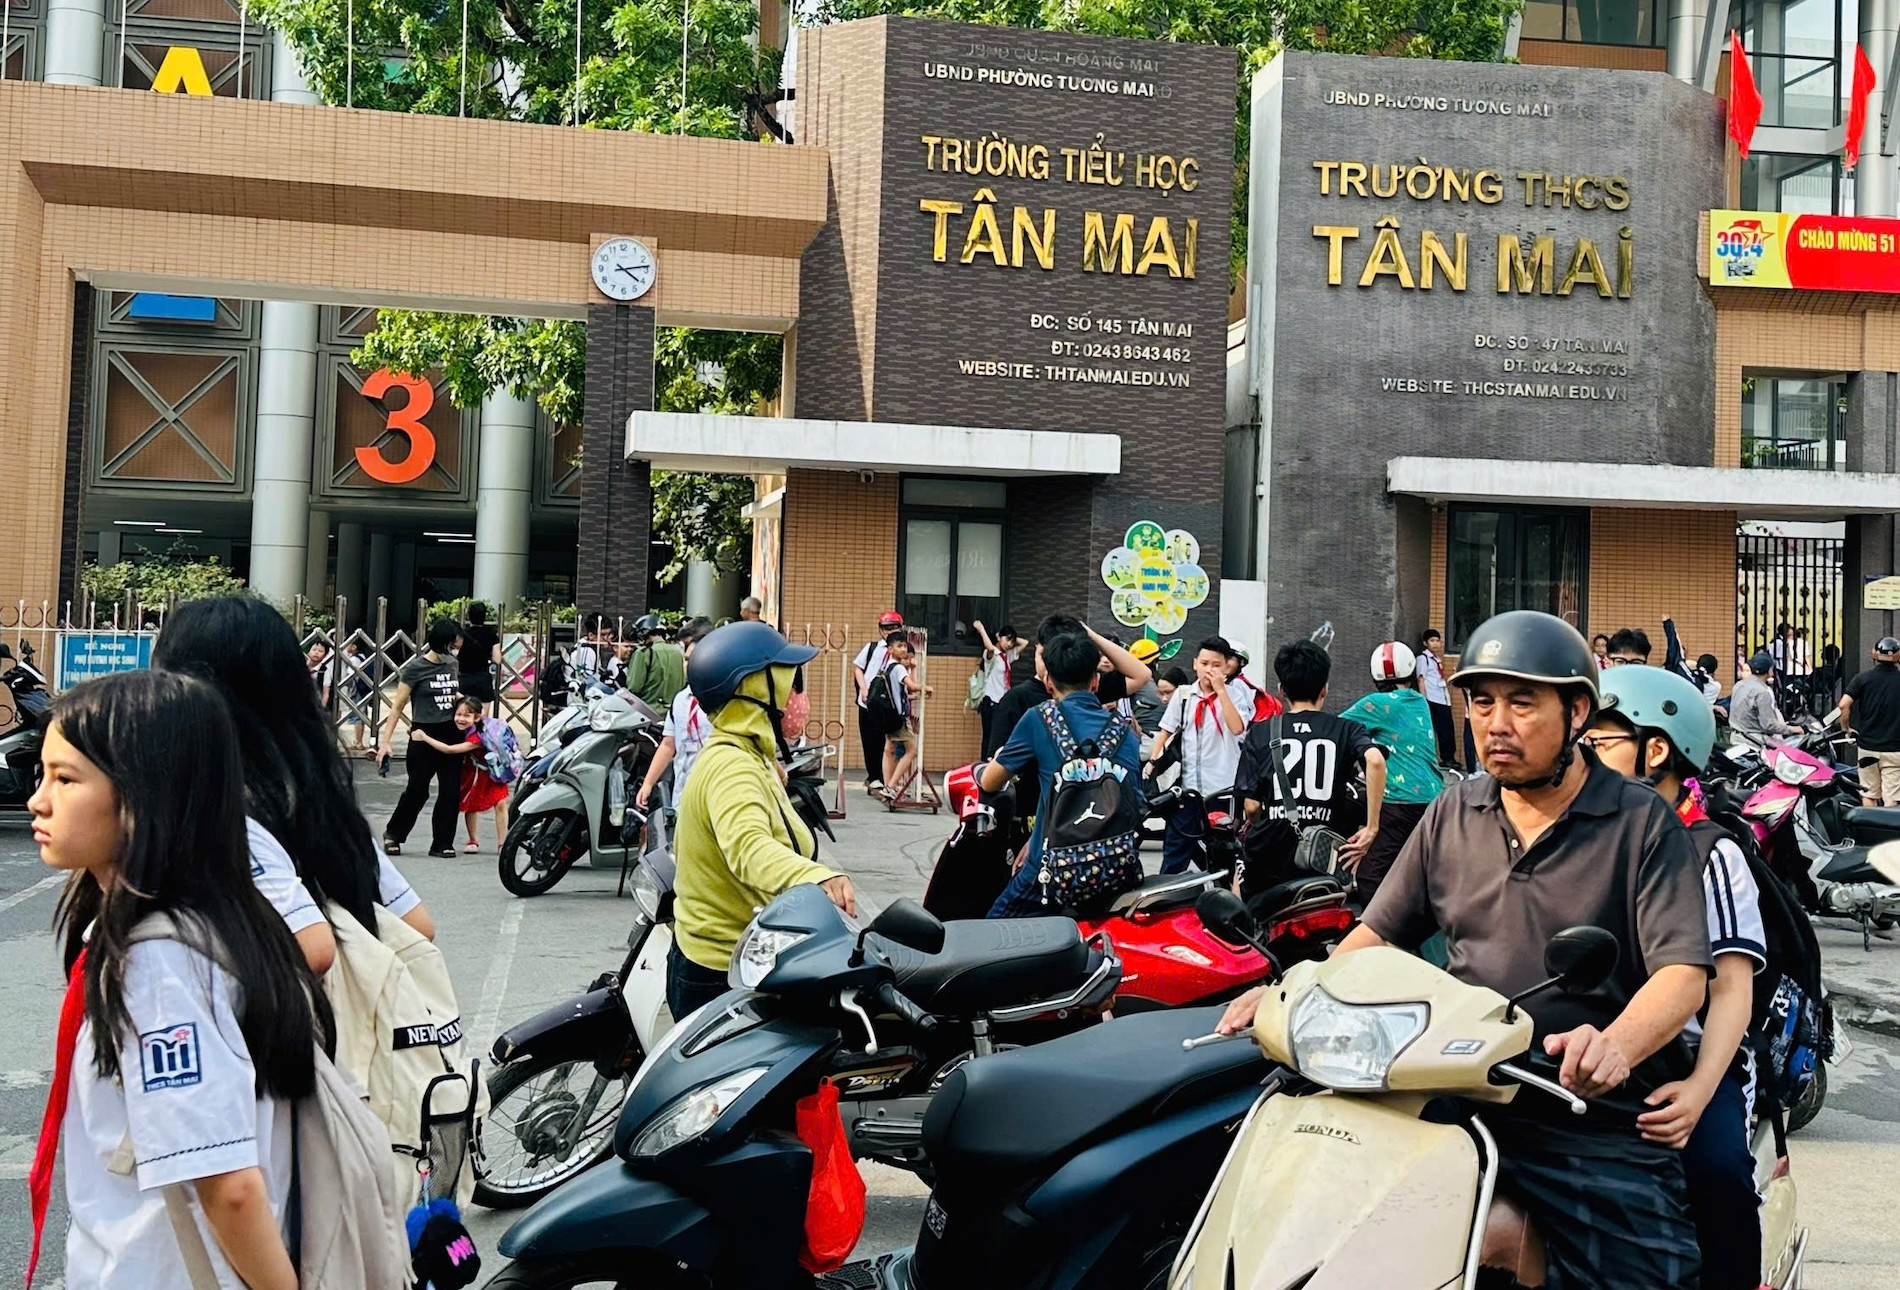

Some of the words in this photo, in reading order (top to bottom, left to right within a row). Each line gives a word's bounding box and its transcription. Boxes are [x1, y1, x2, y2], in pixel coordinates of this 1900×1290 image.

[924, 62, 973, 81] UBND
[978, 66, 1053, 89] PHƯỜNG
[1123, 81, 1154, 97] MAI
[1324, 90, 1370, 108] UBND
[1517, 103, 1549, 118] MAI
[921, 131, 1049, 180] TRƯỜNG
[1060, 132, 1124, 186] TIỂU
[1136, 153, 1199, 198] HỌC
[1312, 156, 1504, 204] TRƯỜNG
[1516, 172, 1631, 211] THCS
[919, 187, 1056, 270] TÂN
[1083, 210, 1199, 279] MAI
[1799, 226, 1834, 249] CHÀO
[1838, 228, 1877, 252] MỪNG
[1880, 235, 1895, 253] 51
[600, 254, 609, 262] 10
[609, 246, 616, 254] 11
[620, 244, 627, 252] 12
[640, 255, 646, 263] 2
[1312, 214, 1468, 291] TÂN
[602, 276, 607, 284] 8
[1030, 314, 1059, 329] ĐC:
[1067, 310, 1092, 331] SỐ
[1096, 318, 1122, 334] 145
[1128, 317, 1159, 336] TÂN
[1163, 321, 1193, 337] MAI
[1051, 340, 1080, 356] ĐT:
[959, 359, 1040, 379] WEBSITE:
[1044, 365, 1190, 387] THTANMAI.EDU.VN
[355, 367, 436, 484] 3
[436, 673, 451, 681] MY
[1293, 722, 1312, 733] TA
[1273, 738, 1336, 801] 20
[407, 1025, 438, 1045] NEW
[1294, 1123, 1361, 1145] HONDA
